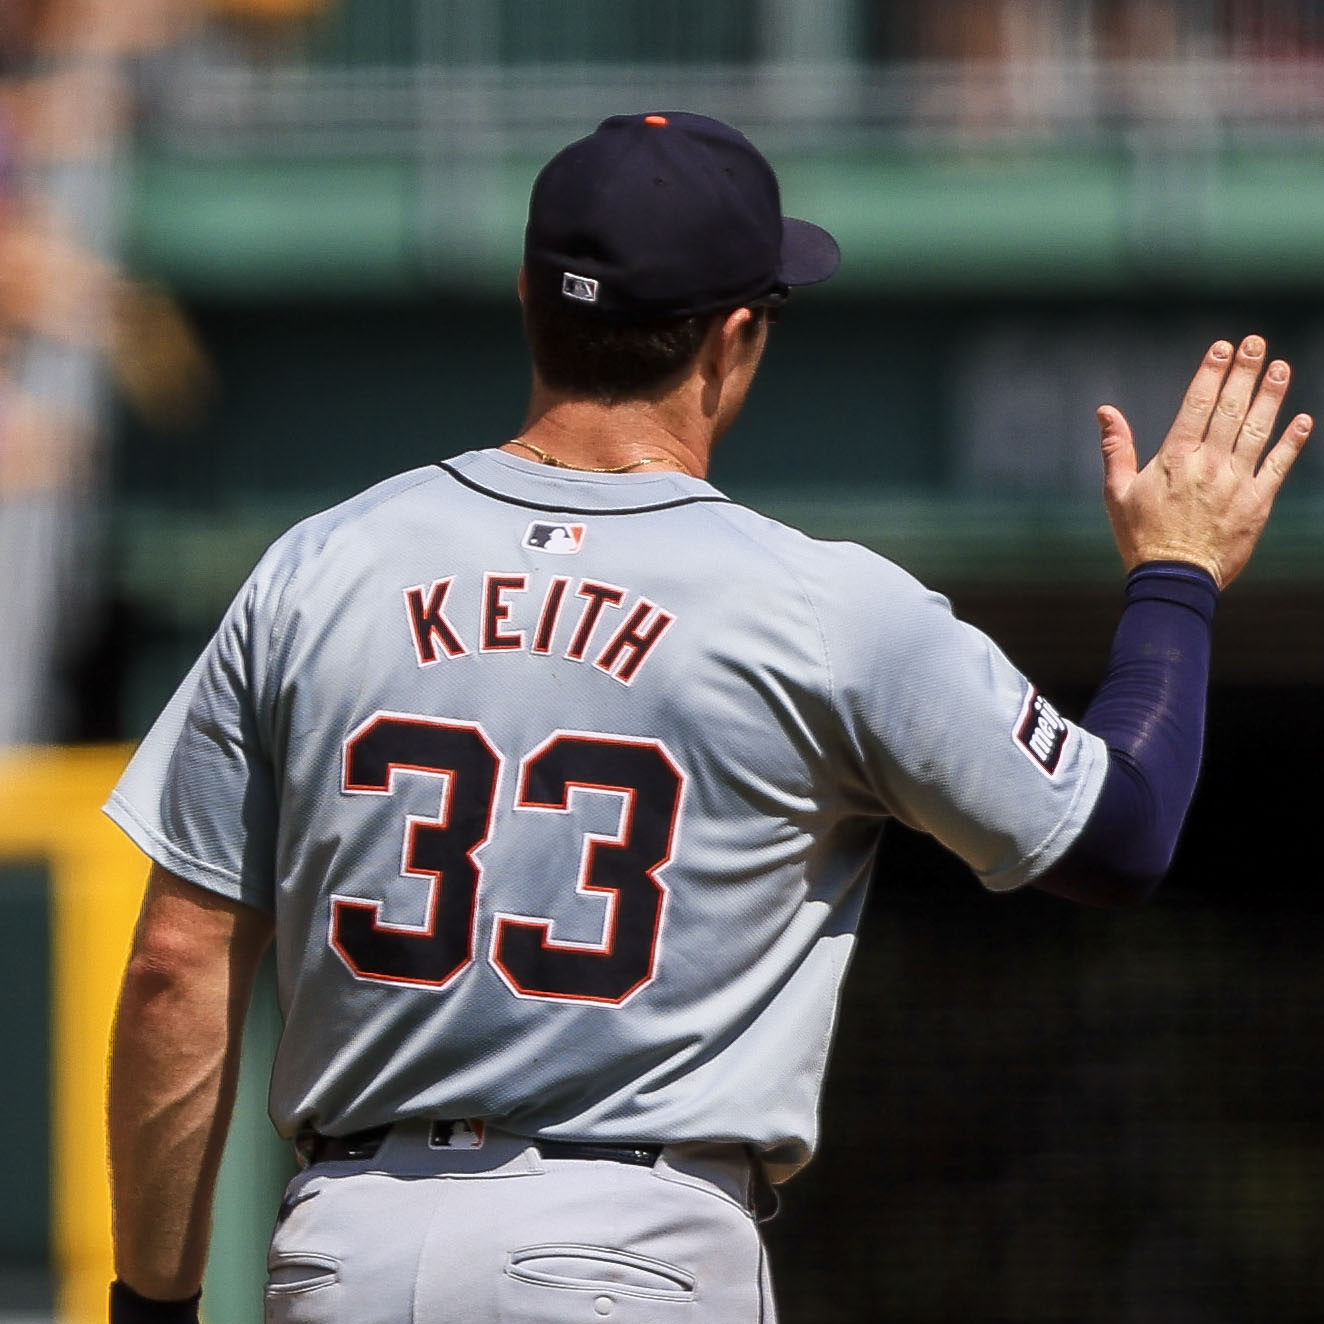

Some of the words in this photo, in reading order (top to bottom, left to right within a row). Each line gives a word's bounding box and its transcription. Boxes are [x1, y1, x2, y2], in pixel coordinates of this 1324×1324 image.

[402, 570, 677, 687] KEITH
[1028, 694, 1067, 762] meij
[328, 710, 688, 1011] 33
